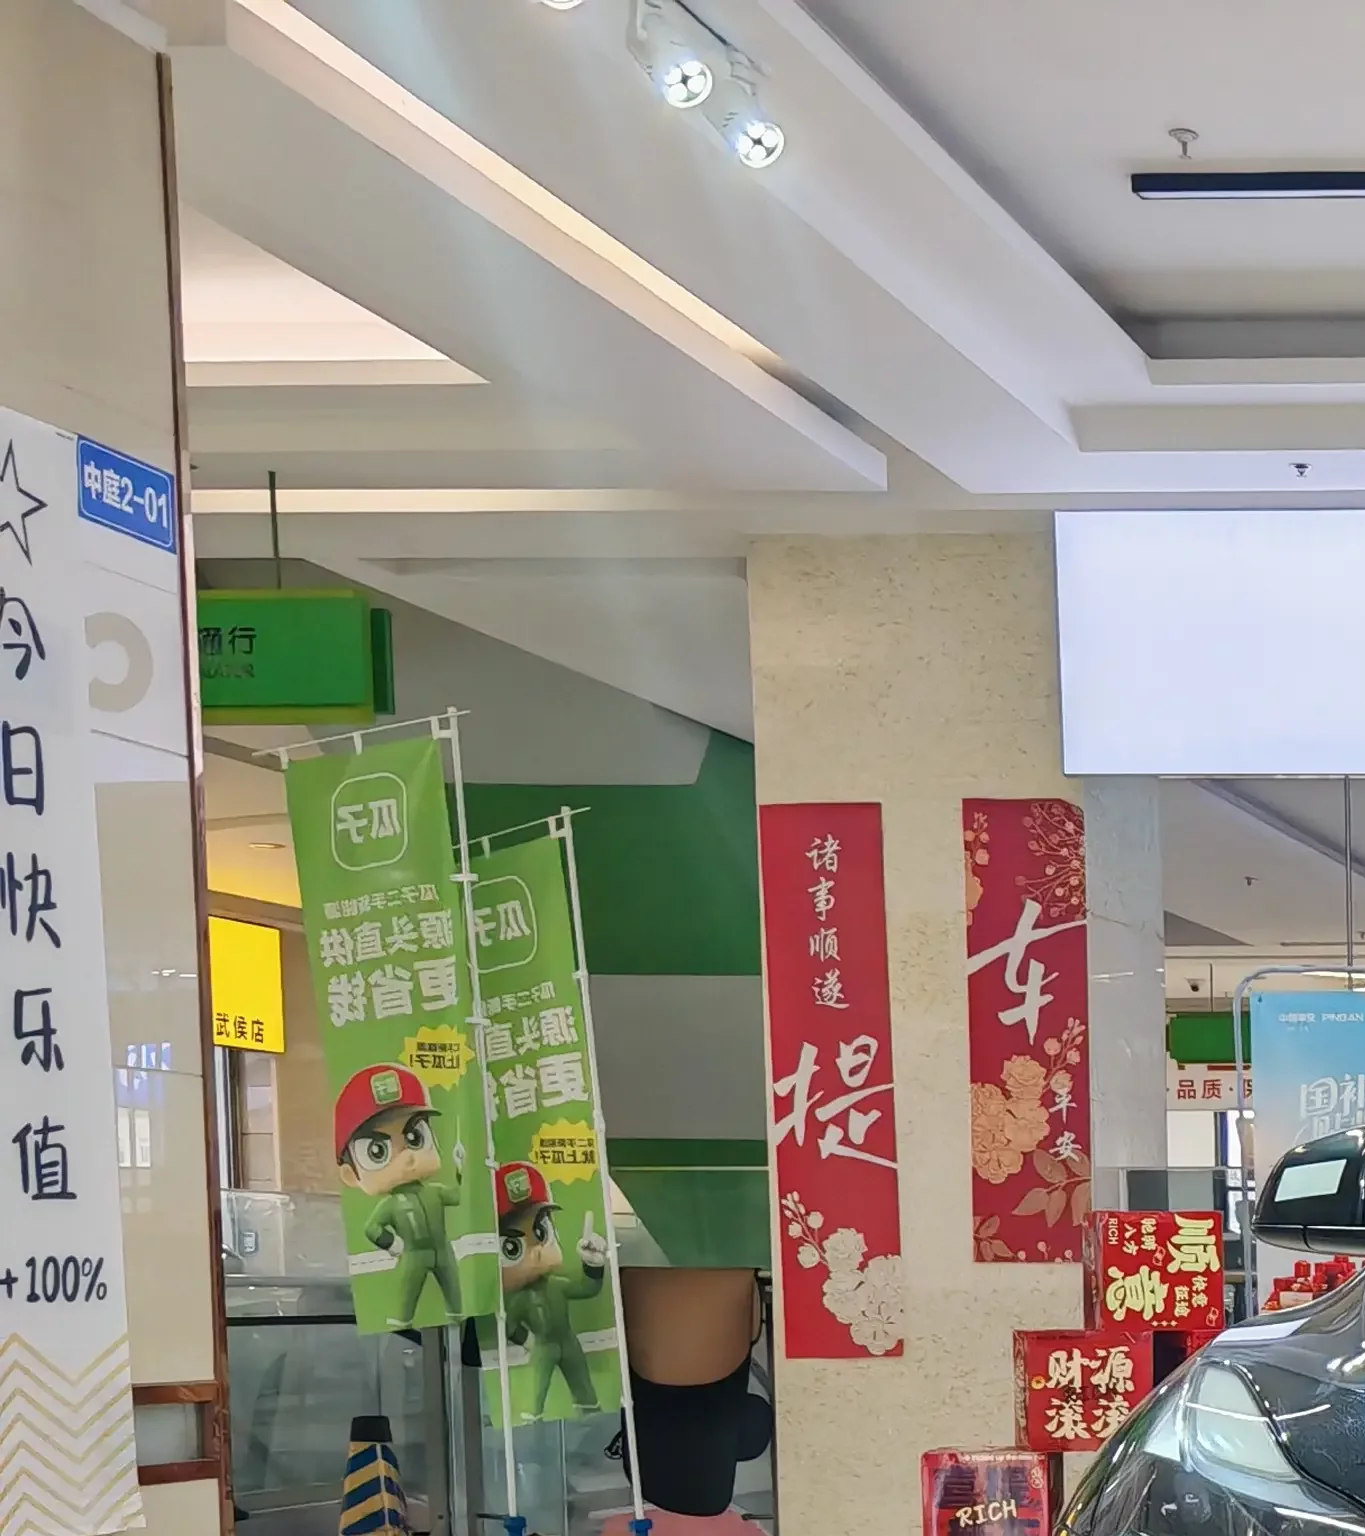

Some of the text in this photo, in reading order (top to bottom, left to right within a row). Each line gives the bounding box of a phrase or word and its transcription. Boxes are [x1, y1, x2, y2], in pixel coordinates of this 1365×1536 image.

[83, 460, 170, 530] 中庭2-01
[806, 834, 851, 1010] 诸事顺遂
[214, 1012, 265, 1044] 武侯店
[1048, 1087, 1083, 1164] 平安
[1107, 1217, 1119, 1246] RICH
[0, 1255, 108, 1304] +100%
[1046, 1345, 1136, 1394] 财源
[955, 1498, 1018, 1529] RICH
